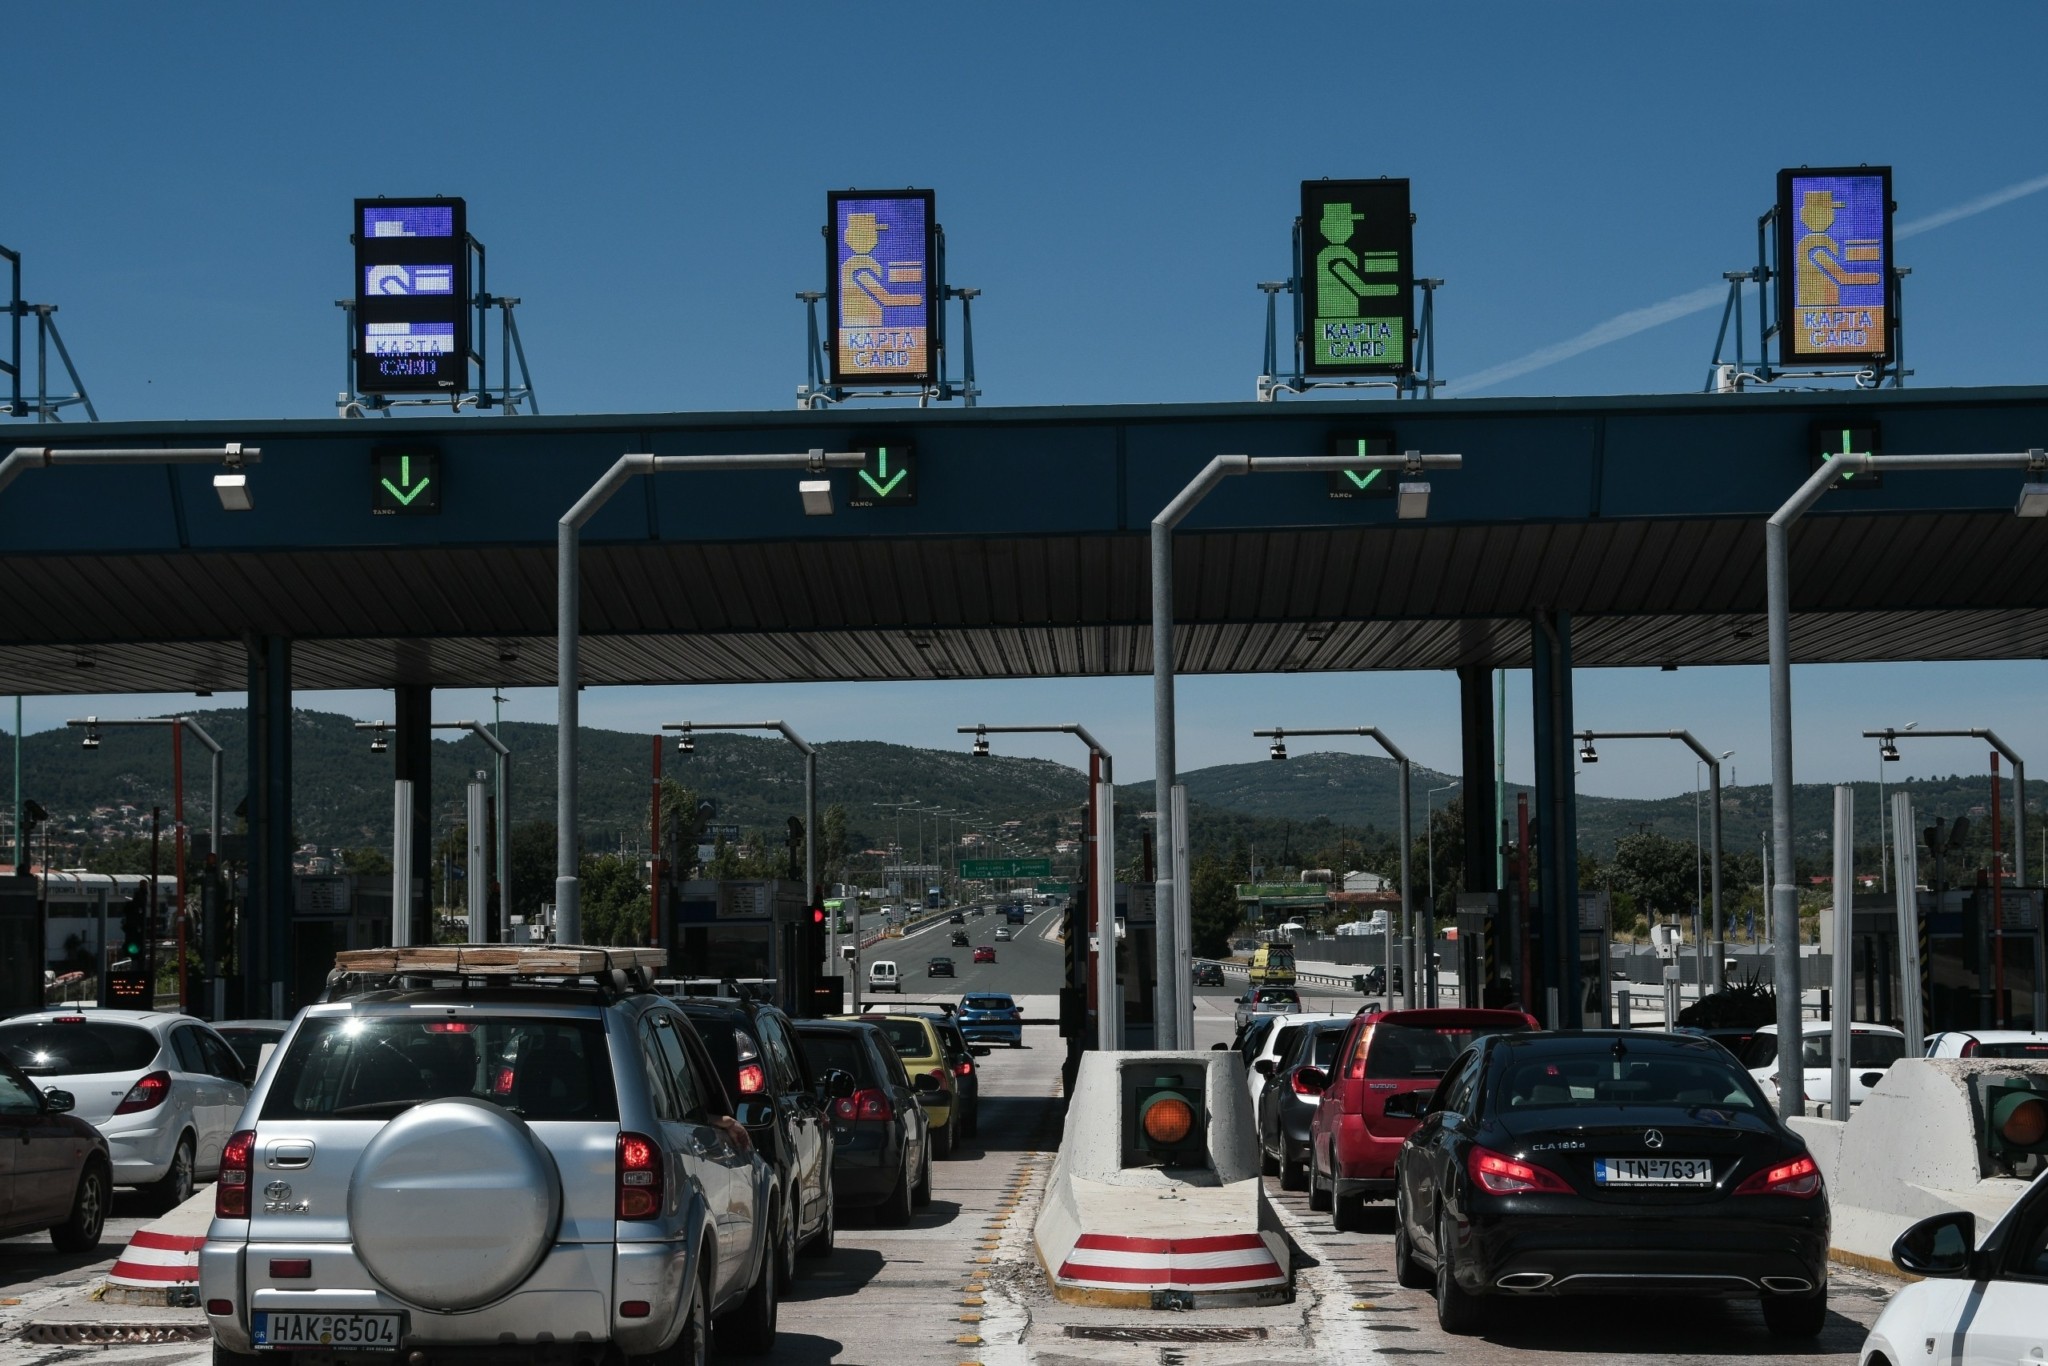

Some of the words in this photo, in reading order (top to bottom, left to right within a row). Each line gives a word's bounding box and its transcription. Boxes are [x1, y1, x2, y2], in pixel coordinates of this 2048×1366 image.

[1803, 311, 1873, 329] ΚΑΡΤΑ
[1324, 322, 1392, 340] ΚΑΡΤΑ
[1810, 330, 1868, 347] CARD
[849, 332, 916, 349] ΚΑΡΤΑ
[1330, 341, 1385, 358] CARD
[854, 351, 910, 368] CARD
[263, 1201, 310, 1214] RAV4
